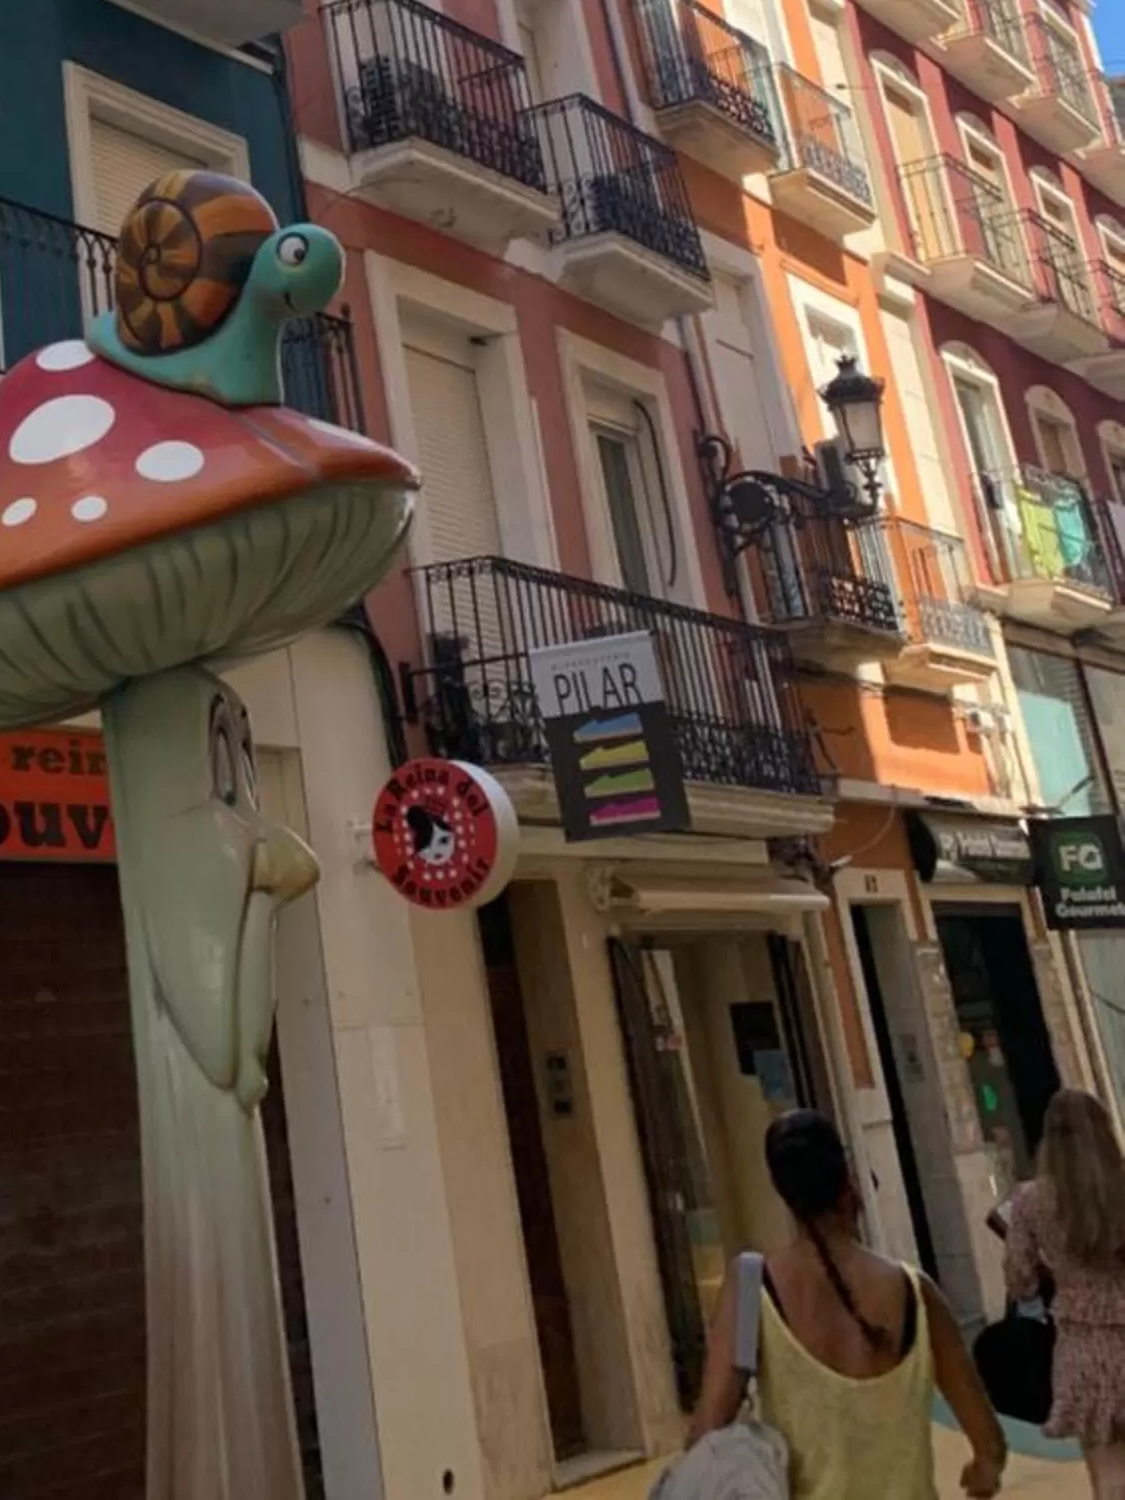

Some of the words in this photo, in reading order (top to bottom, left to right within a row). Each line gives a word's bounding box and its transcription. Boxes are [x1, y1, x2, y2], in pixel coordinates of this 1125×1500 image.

[553, 662, 647, 716] PILAR
[9, 739, 107, 777] rein
[375, 803, 397, 833] La
[386, 763, 450, 801] Reina
[456, 777, 489, 816] del
[391, 857, 490, 907] Souvenir
